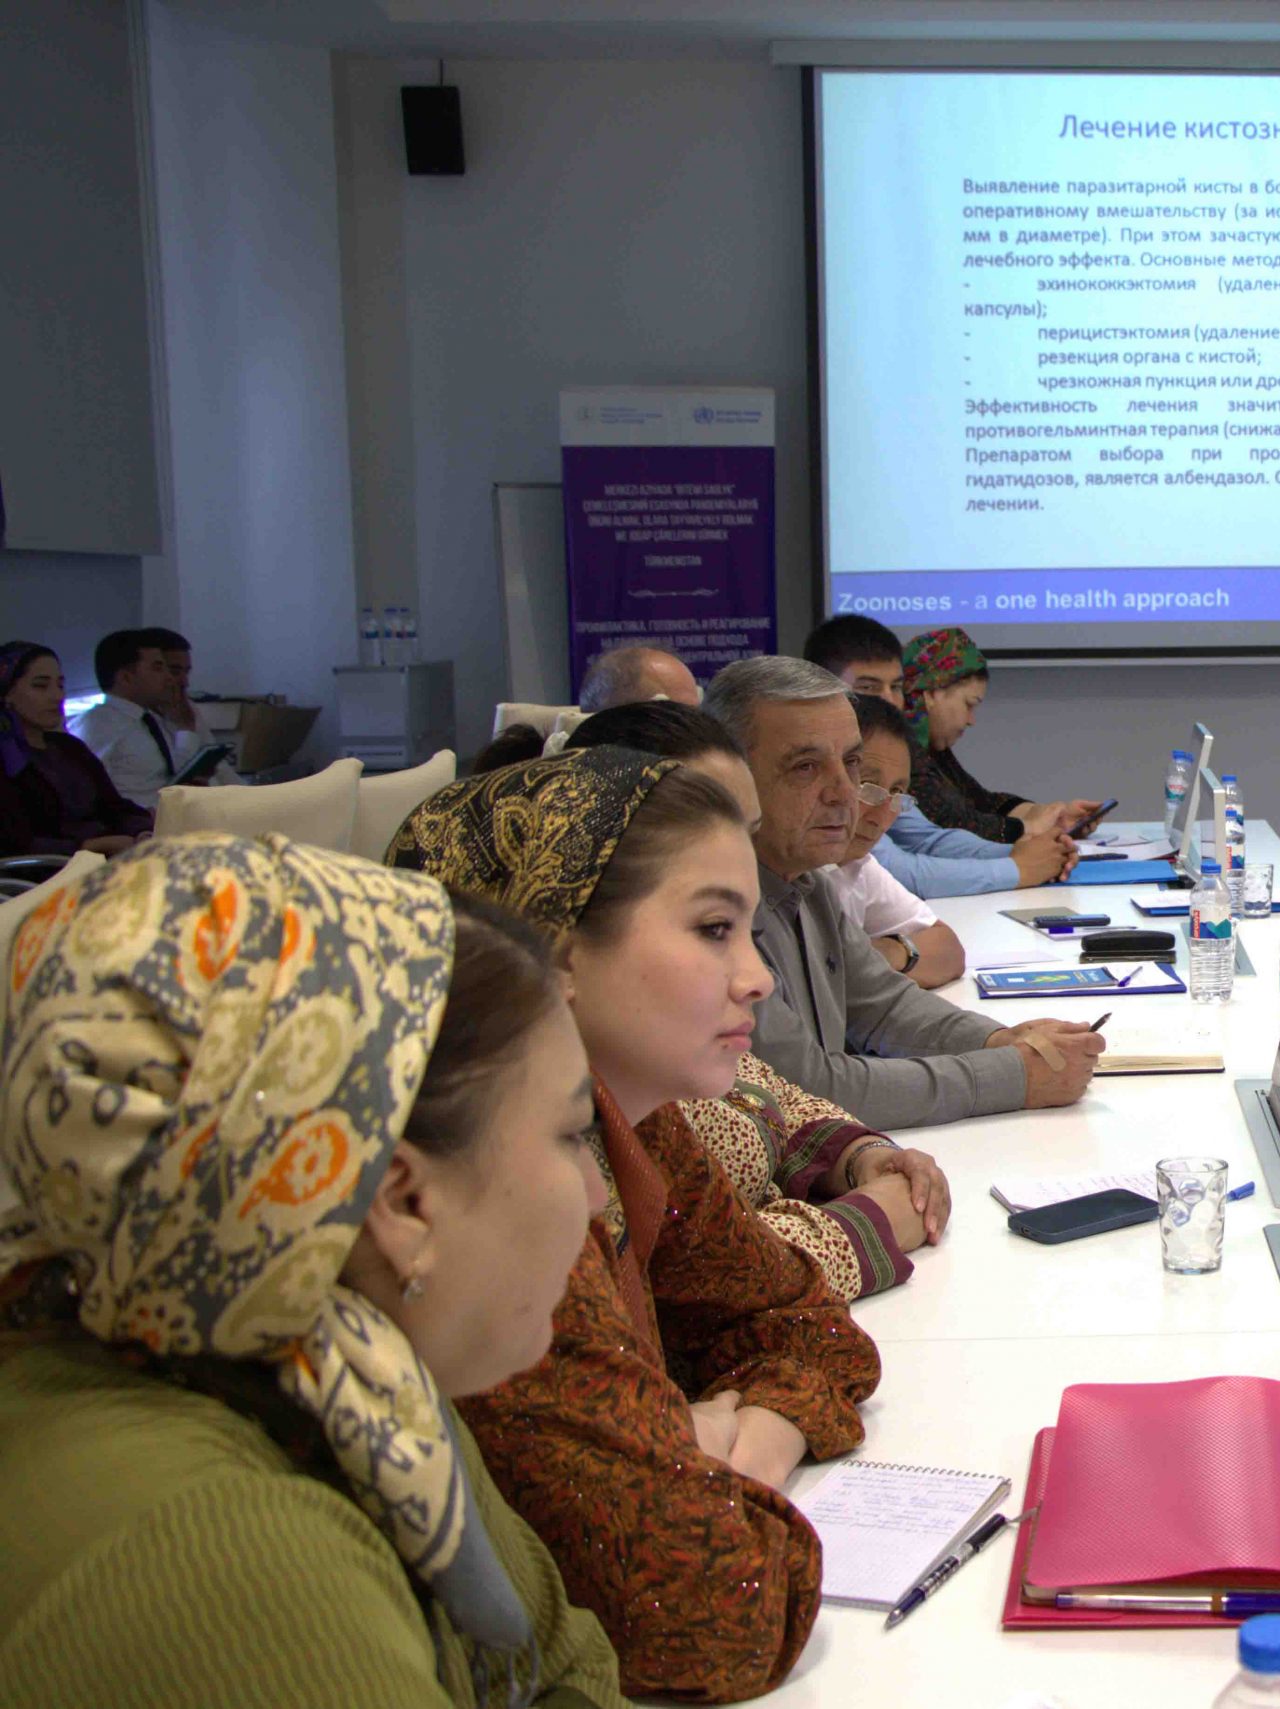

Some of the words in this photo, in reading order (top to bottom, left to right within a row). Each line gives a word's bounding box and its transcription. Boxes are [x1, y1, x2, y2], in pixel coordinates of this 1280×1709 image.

[1059, 114, 1177, 139] Лечение
[963, 178, 1061, 194] Выявление
[1066, 177, 1187, 197] паразитарной
[1193, 182, 1243, 194] кисты
[1249, 182, 1259, 194] в
[962, 205, 1090, 222] оперативному
[1096, 205, 1227, 221] вмешательству
[1234, 203, 1258, 221] (за
[963, 230, 991, 243] мм
[998, 230, 1009, 243] в
[1015, 226, 1111, 246] диаметре).
[1120, 227, 1154, 245] При
[1162, 230, 1202, 242] этом
[963, 251, 1055, 268] лечебного
[1058, 251, 1136, 271] эффекта.
[1140, 251, 1227, 267] Основные
[1037, 279, 1197, 292] эхинококкэктомия
[964, 299, 1047, 320] капсулы);
[1037, 327, 1191, 344] перицистэктомия
[1194, 324, 1280, 343] (удаление
[1038, 352, 1119, 368] резекция
[1122, 351, 1181, 367] органа
[1185, 351, 1194, 364] с
[1198, 347, 1262, 367] кистой;
[1037, 376, 1142, 392] чрезкожная
[1145, 375, 1217, 392] пункция
[1220, 377, 1254, 389] или
[965, 398, 1098, 417] Эффективность
[1126, 400, 1198, 413] лечения
[965, 424, 1148, 442] противогельминтная
[1149, 424, 1219, 442] терапия
[965, 447, 1072, 466] Препаратом
[1099, 445, 1164, 465] выбора
[1191, 448, 1223, 464] при
[965, 473, 1079, 490] гидатидозов,
[1084, 472, 1159, 486] является
[1164, 469, 1270, 488] албендазол.
[965, 498, 1044, 512] лечении.
[838, 593, 952, 612] Zoonoses
[975, 597, 988, 610] a
[995, 593, 1037, 610] one
[1046, 588, 1117, 610] health
[1123, 588, 1230, 613] approach
